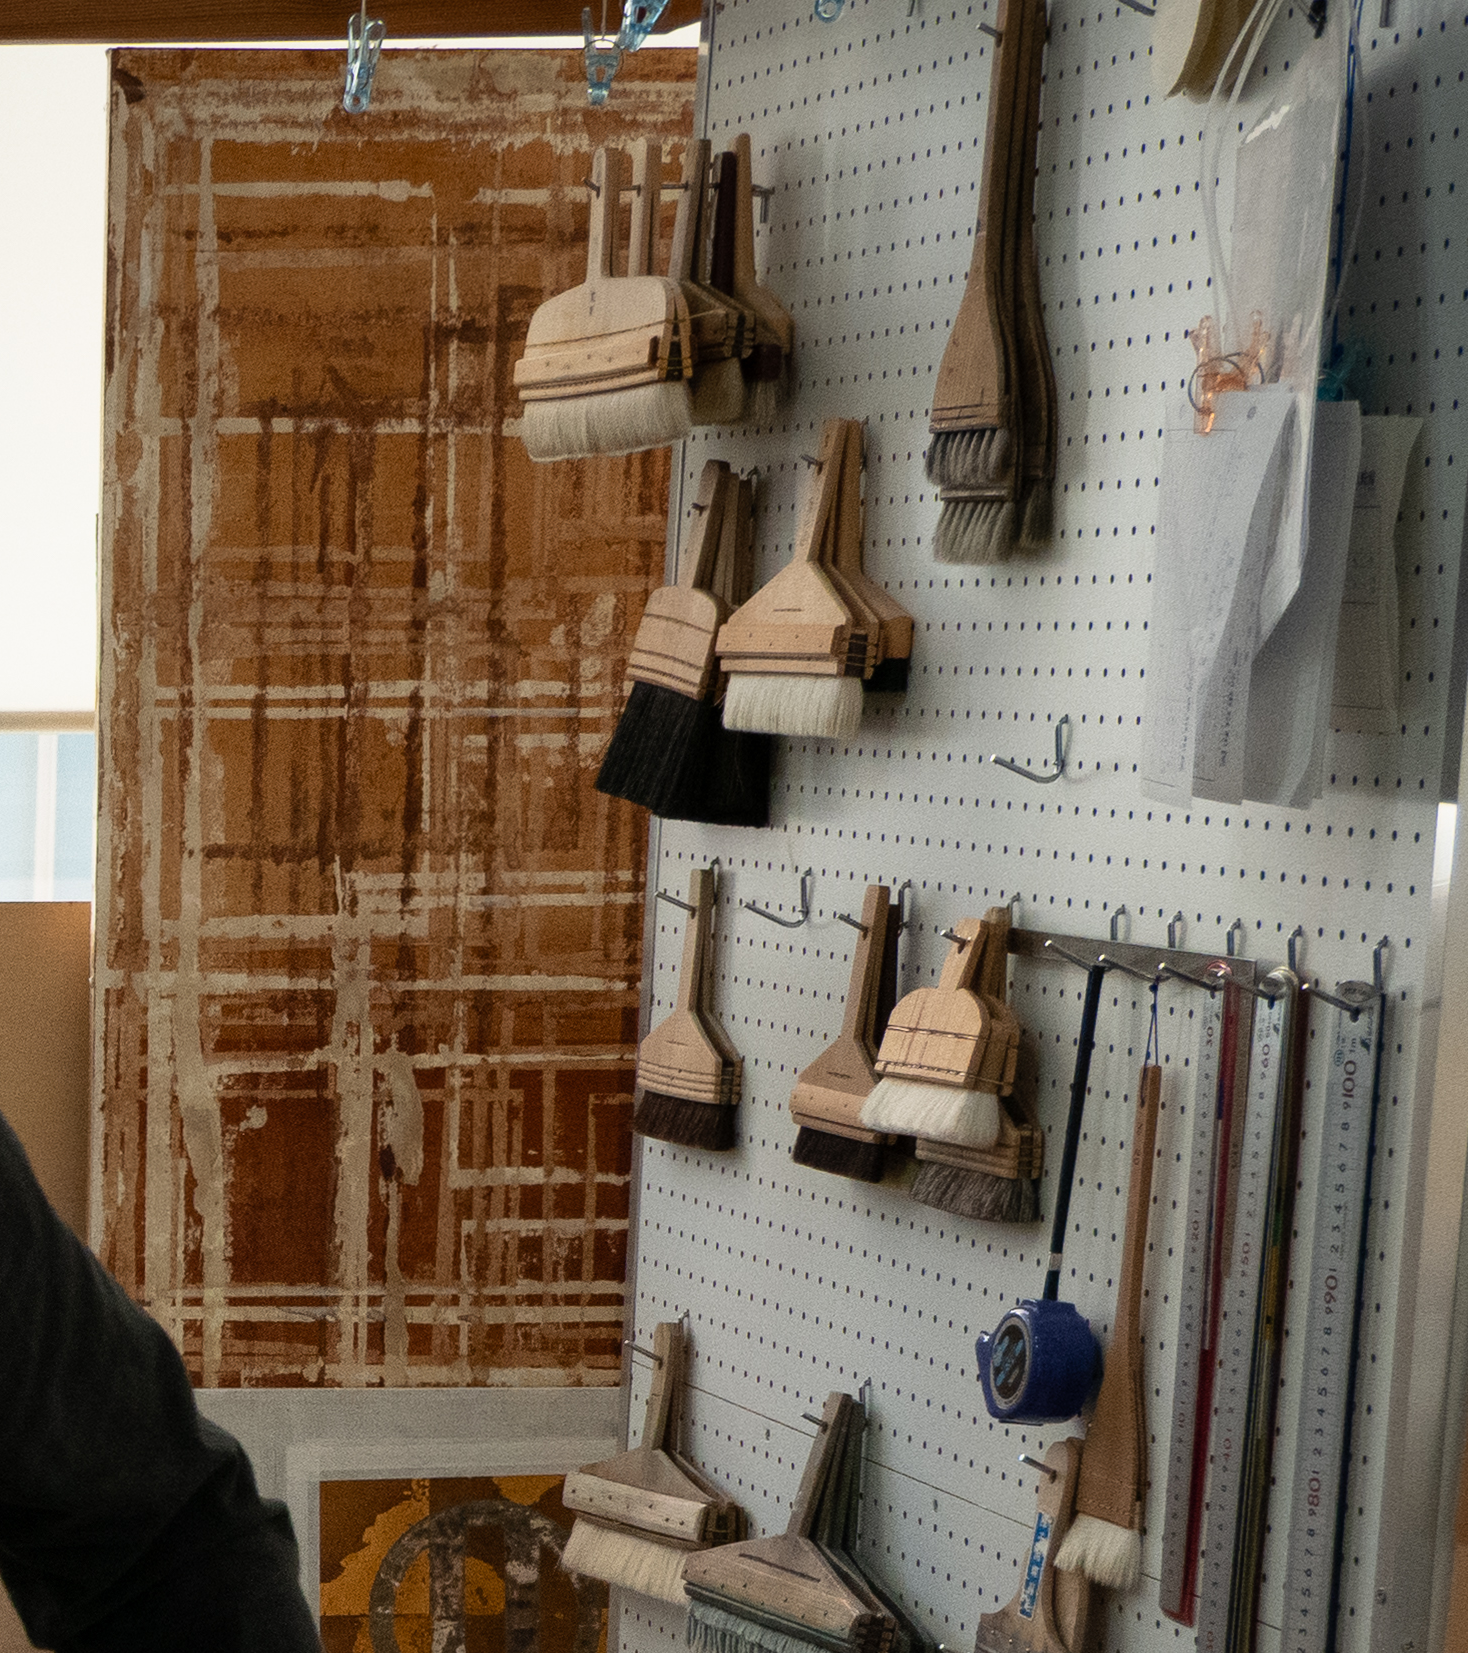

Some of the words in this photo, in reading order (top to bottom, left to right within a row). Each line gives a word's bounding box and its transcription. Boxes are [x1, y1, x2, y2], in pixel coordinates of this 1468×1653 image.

[1342, 1060, 1357, 1099] 100
[1342, 1101, 1352, 1110] 9
[1341, 1122, 1350, 1131] 8
[1338, 1142, 1348, 1151] 7
[1337, 1163, 1347, 1173] 6
[1334, 1183, 1345, 1193] 5
[1334, 1204, 1343, 1214] 4
[1331, 1244, 1340, 1254] 2
[1324, 1275, 1338, 1304] 90
[1325, 1306, 1334, 1315] 9
[1323, 1326, 1333, 1336] 8
[1321, 1347, 1330, 1355] 7
[1320, 1367, 1329, 1377] 6
[1317, 1387, 1328, 1397] 5
[1317, 1408, 1326, 1416] 4
[1314, 1428, 1324, 1436] 3
[1312, 1447, 1323, 1456] 2
[1307, 1477, 1321, 1507] 80
[1308, 1508, 1317, 1517] 9
[1306, 1528, 1316, 1538] 8
[1304, 1548, 1315, 1556] 7
[1303, 1568, 1313, 1578] 6
[1301, 1587, 1312, 1598] 5
[1300, 1608, 1309, 1617] 4
[1298, 1628, 1308, 1636] 3
